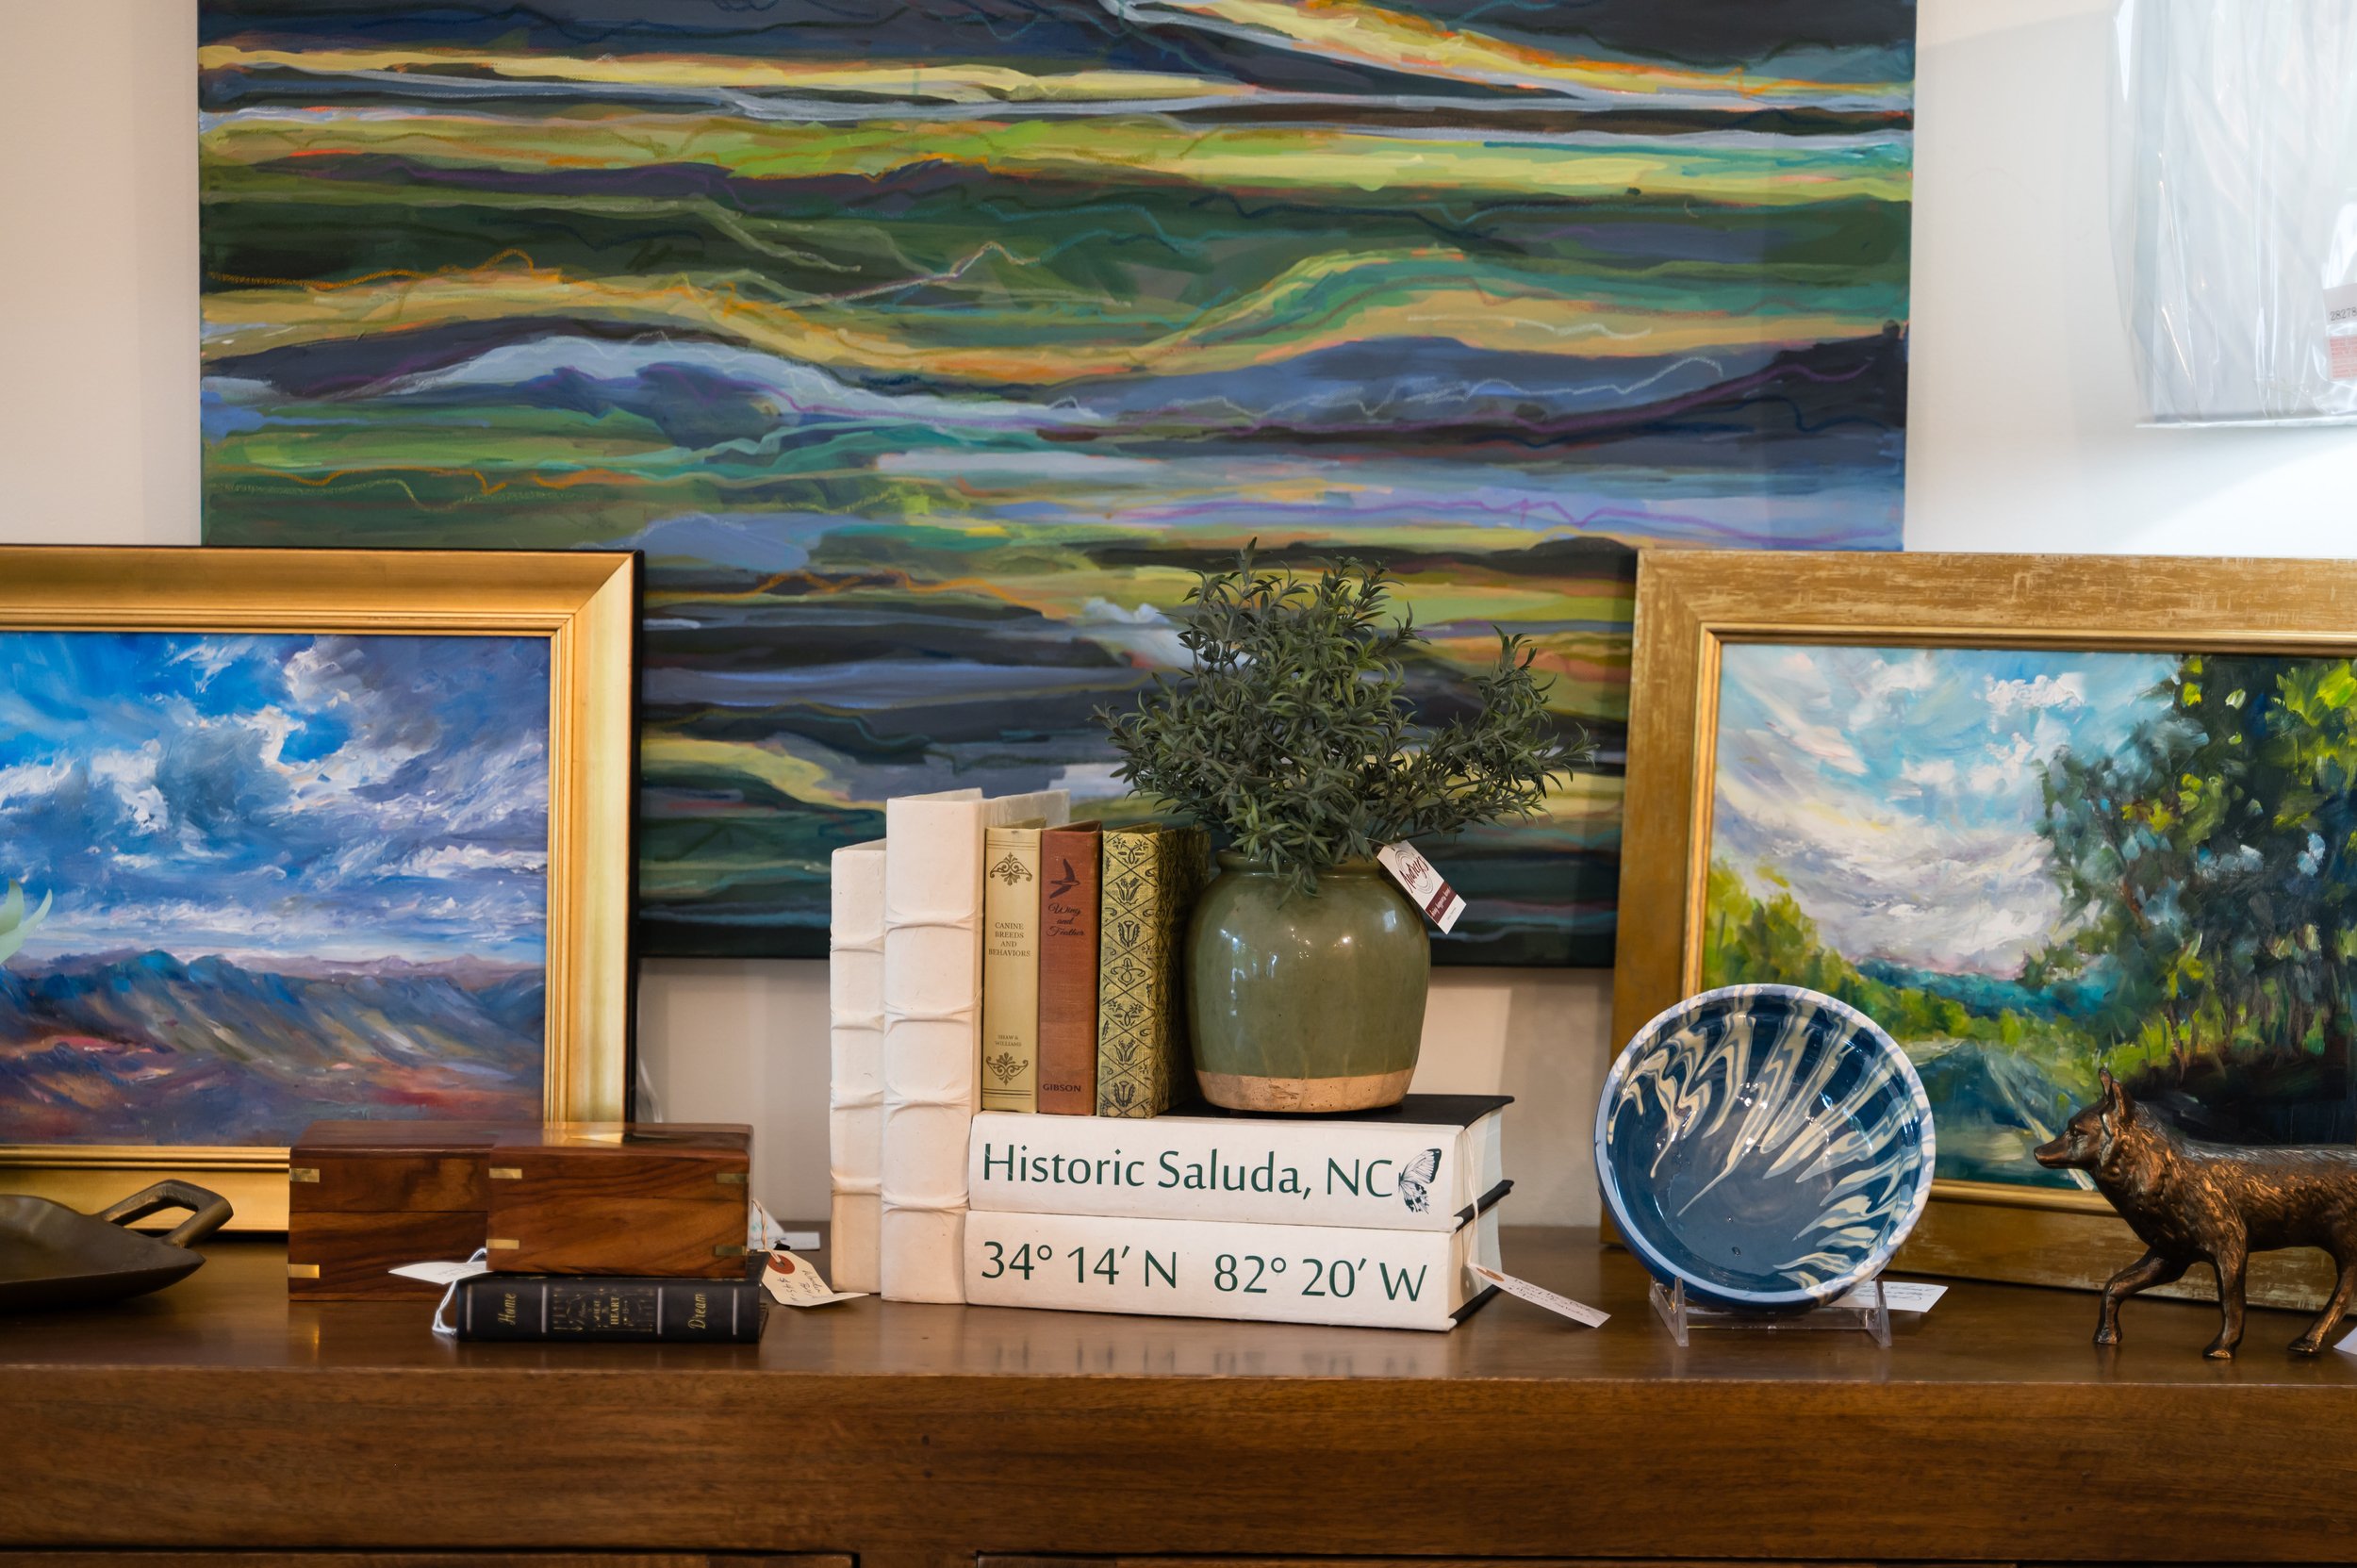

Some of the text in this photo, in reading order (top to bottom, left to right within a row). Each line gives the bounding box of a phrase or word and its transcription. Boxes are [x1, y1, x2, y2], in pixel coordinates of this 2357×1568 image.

[1047, 902, 1081, 917] Wing
[995, 921, 1024, 930] CANINE
[1047, 925, 1084, 936] Feather
[988, 948, 1031, 957] BEHAVIORS
[1043, 1083, 1081, 1092] GIBSON
[984, 1144, 1393, 1199] Historic Saluda, NC
[981, 1241, 1053, 1280] 34°
[1146, 1250, 1176, 1289] N
[1214, 1253, 1287, 1293] 82°
[1379, 1263, 1427, 1302] W
[610, 1296, 619, 1326] HEART
[687, 1293, 706, 1329] Dream
